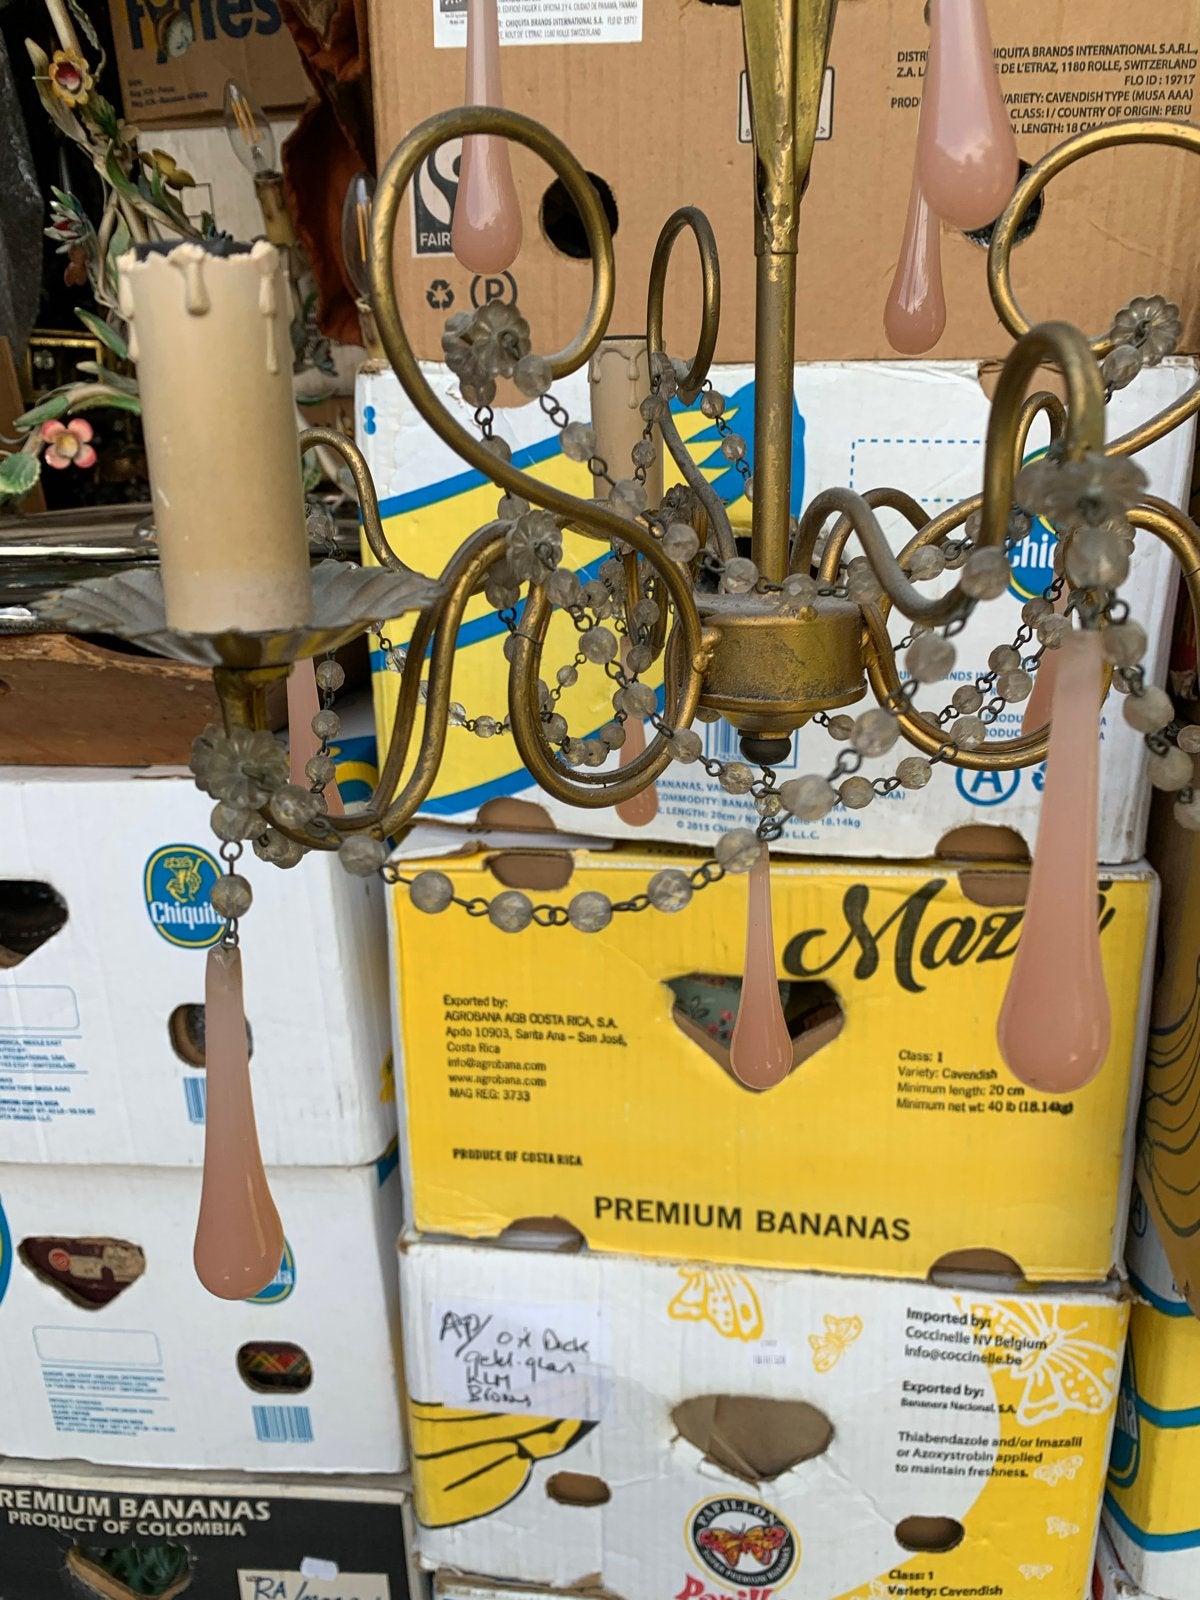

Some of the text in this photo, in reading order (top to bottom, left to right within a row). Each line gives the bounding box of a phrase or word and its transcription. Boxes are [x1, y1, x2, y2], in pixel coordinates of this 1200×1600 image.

[505, 18, 529, 28] CHIQUITA
[531, 17, 552, 27] BRANDS
[553, 16, 592, 26] INTERNATIONAL
[1032, 45, 1074, 57] BRANDS
[1076, 44, 1156, 56] INTERNATIONAL
[897, 67, 916, 78] Z.A.
[1001, 63, 1016, 74] DE
[1062, 61, 1086, 72] 1180
[1088, 60, 1122, 72] ROLLE,
[1124, 59, 1197, 70] SWITZERLAND
[1124, 75, 1144, 86] FLO
[1146, 75, 1157, 85] ID
[1165, 74, 1196, 85] 19717
[1046, 92, 1104, 103] CAVENDISH
[1105, 91, 1130, 102] TYPE
[1132, 90, 1166, 102] (MUSA
[1168, 88, 1194, 101] AAA)
[1010, 108, 1044, 119] CLASS:
[1057, 106, 1106, 118] COUNTRY
[1108, 106, 1122, 117] OF
[1124, 105, 1163, 116] ORIGIN:
[1165, 105, 1192, 115] PERU
[1021, 122, 1064, 134] LENGTH:
[1066, 123, 1078, 133] 18
[421, 232, 451, 247] FAIR
[666, 806, 708, 818] LENGTH:
[443, 995, 508, 1009] Exported by:
[444, 1011, 618, 1029] AGROBANA AGB COSTA RICA, S.A.
[446, 1027, 472, 1040] Apdo
[475, 1027, 513, 1040] 10903,
[515, 1029, 544, 1041] Santa
[546, 1031, 566, 1042] Ana
[578, 1032, 597, 1043] San
[446, 1041, 501, 1054] Costa Rica
[898, 1050, 932, 1062] Class:
[448, 1057, 547, 1072] info@agrobana.com
[898, 1066, 998, 1080] Variety: Cavendish
[448, 1074, 547, 1088] www.agrobana.com
[449, 1088, 531, 1102] MAG REG: 3733
[897, 1082, 1025, 1099] Minimum length: 20 cm
[896, 1097, 1074, 1115] Minimum net wt: 40 lb (18.14kg)
[453, 1148, 583, 1166] PRODUCE OF COSTA RICA
[594, 1196, 912, 1242] PREMIUM BANANAS
[906, 1308, 992, 1329] Imported by:
[905, 1326, 1047, 1352] Coccinelle NV Belgium
[905, 1344, 1023, 1366] info@coccinelle.be
[902, 1381, 984, 1398] Exported by:
[901, 1398, 947, 1410] Bananera
[898, 1431, 1083, 1448] Thiabendazole and/or Imazalil
[897, 1448, 1043, 1465] or Azoxystrobin applied
[895, 1464, 1029, 1479] to maintain freshness.
[0, 1488, 271, 1521] REMIUM BANANAS
[8, 1510, 246, 1537] PRODUCT OF COLOMBIA
[889, 1569, 925, 1580] Class:
[888, 1585, 1003, 1598] Variety: Cavendish
